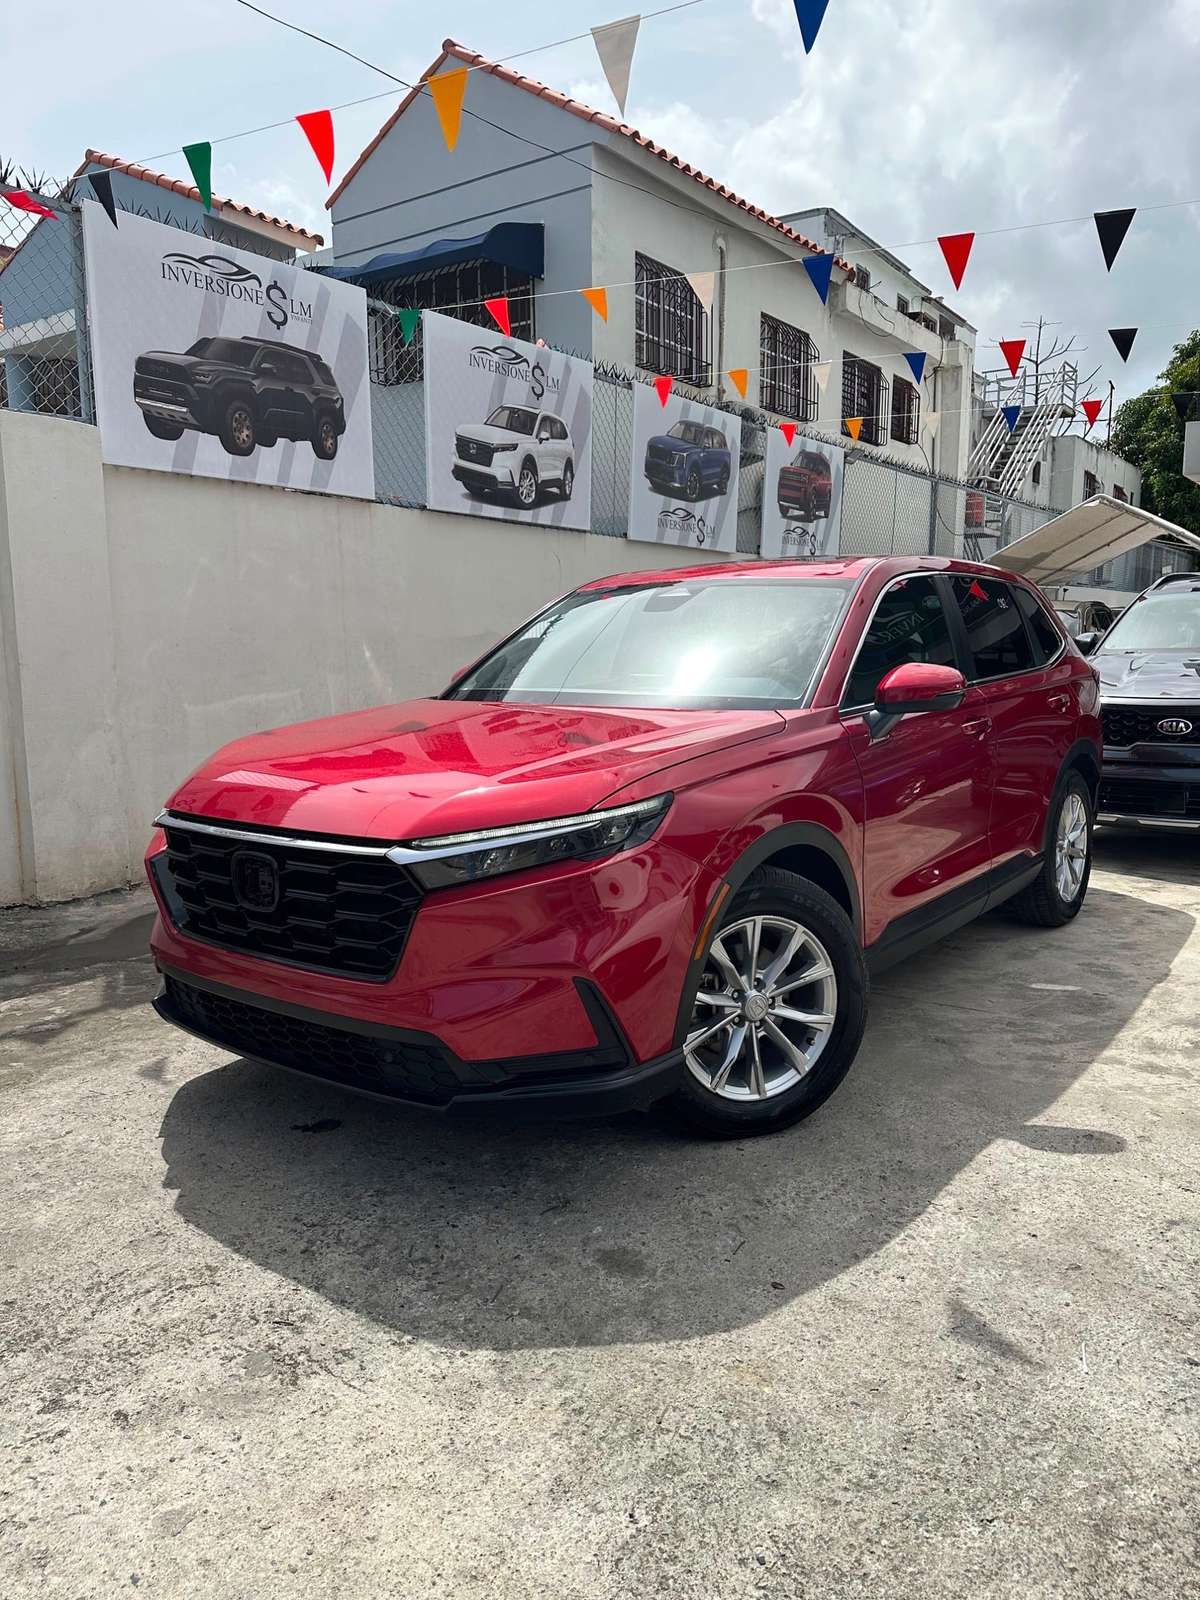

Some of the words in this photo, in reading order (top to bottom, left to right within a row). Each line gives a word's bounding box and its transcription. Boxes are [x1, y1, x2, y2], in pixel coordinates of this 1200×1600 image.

[290, 299, 312, 318] LM
[546, 376, 560, 391] LM
[1163, 721, 1186, 732] KIA
